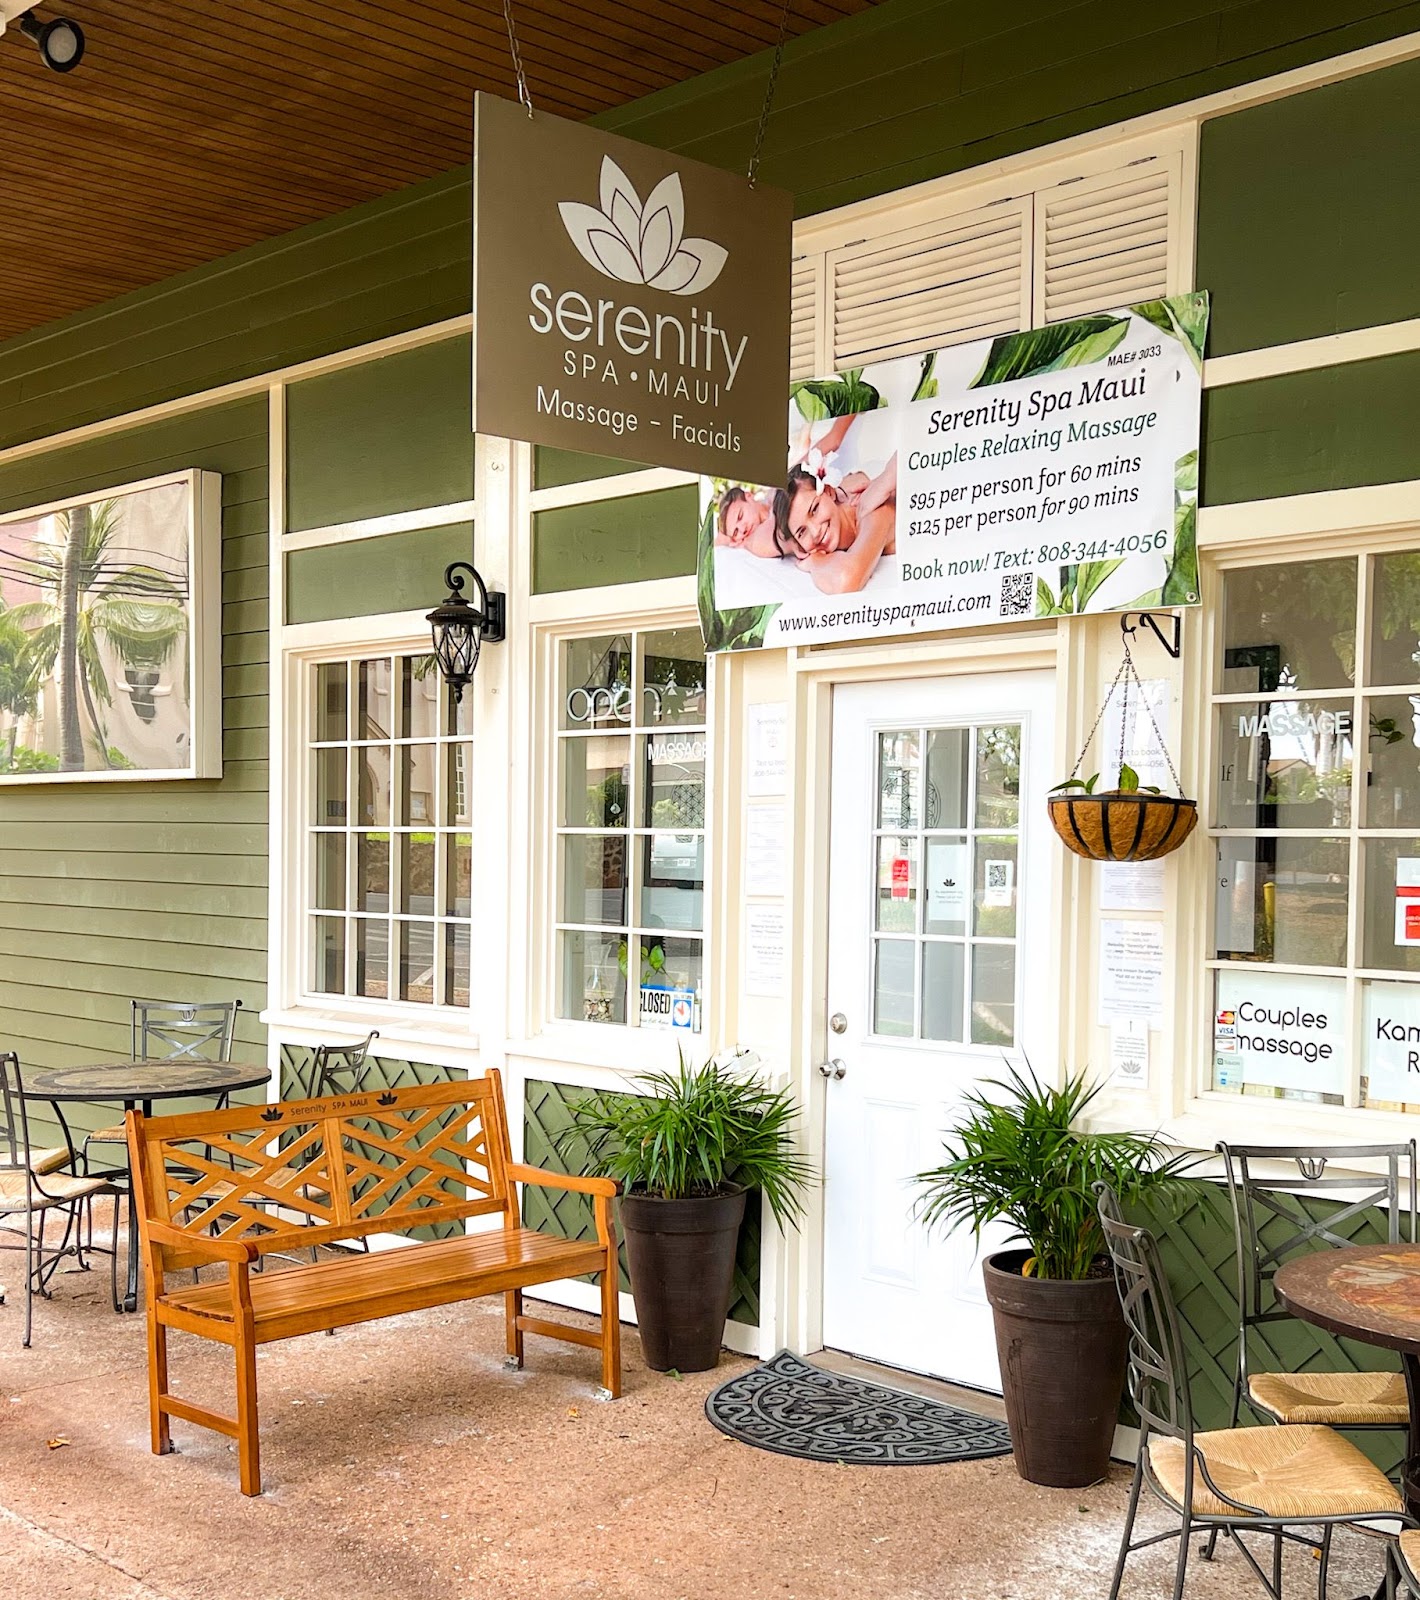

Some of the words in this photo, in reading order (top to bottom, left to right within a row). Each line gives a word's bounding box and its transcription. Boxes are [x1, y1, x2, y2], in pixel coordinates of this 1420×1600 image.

[528, 282, 748, 391] serenity
[1107, 352, 1136, 367] MAE#
[1138, 345, 1161, 360] 3033
[563, 350, 619, 385] SPA
[649, 369, 718, 407] MAUI
[928, 398, 1021, 434] Serenity
[1028, 390, 1072, 421] Spa
[1077, 368, 1146, 406] Maui
[537, 385, 638, 435] Massage
[672, 414, 741, 452] Facials
[908, 443, 976, 471] Couples
[981, 429, 1062, 458] Relaxing
[1067, 412, 1157, 443] Massage
[909, 491, 936, 510] $95
[939, 486, 968, 509] per
[971, 476, 1034, 504] person
[1036, 467, 1066, 495] for
[1070, 464, 1092, 483] 60
[1096, 455, 1141, 478] mins
[909, 519, 940, 537] $125
[945, 514, 972, 536] per
[977, 505, 1036, 531] person
[1037, 497, 1066, 523] for
[1068, 495, 1090, 515] 90
[1094, 485, 1139, 508] mins
[902, 558, 943, 581] Book
[948, 553, 990, 576] now!
[993, 548, 1034, 570] Text:
[1037, 529, 1168, 563] 808-344-4056
[779, 594, 991, 632] www.serenityspamaui.com
[567, 687, 661, 730] open
[1239, 711, 1351, 738] MASSAGE
[1114, 748, 1130, 757] Txt
[1239, 1002, 1328, 1031] Couples
[1236, 1034, 1332, 1063] massage
[290, 1103, 327, 1116] Serenity
[332, 1101, 347, 1110] SPA
[350, 1098, 368, 1107] MAUI
